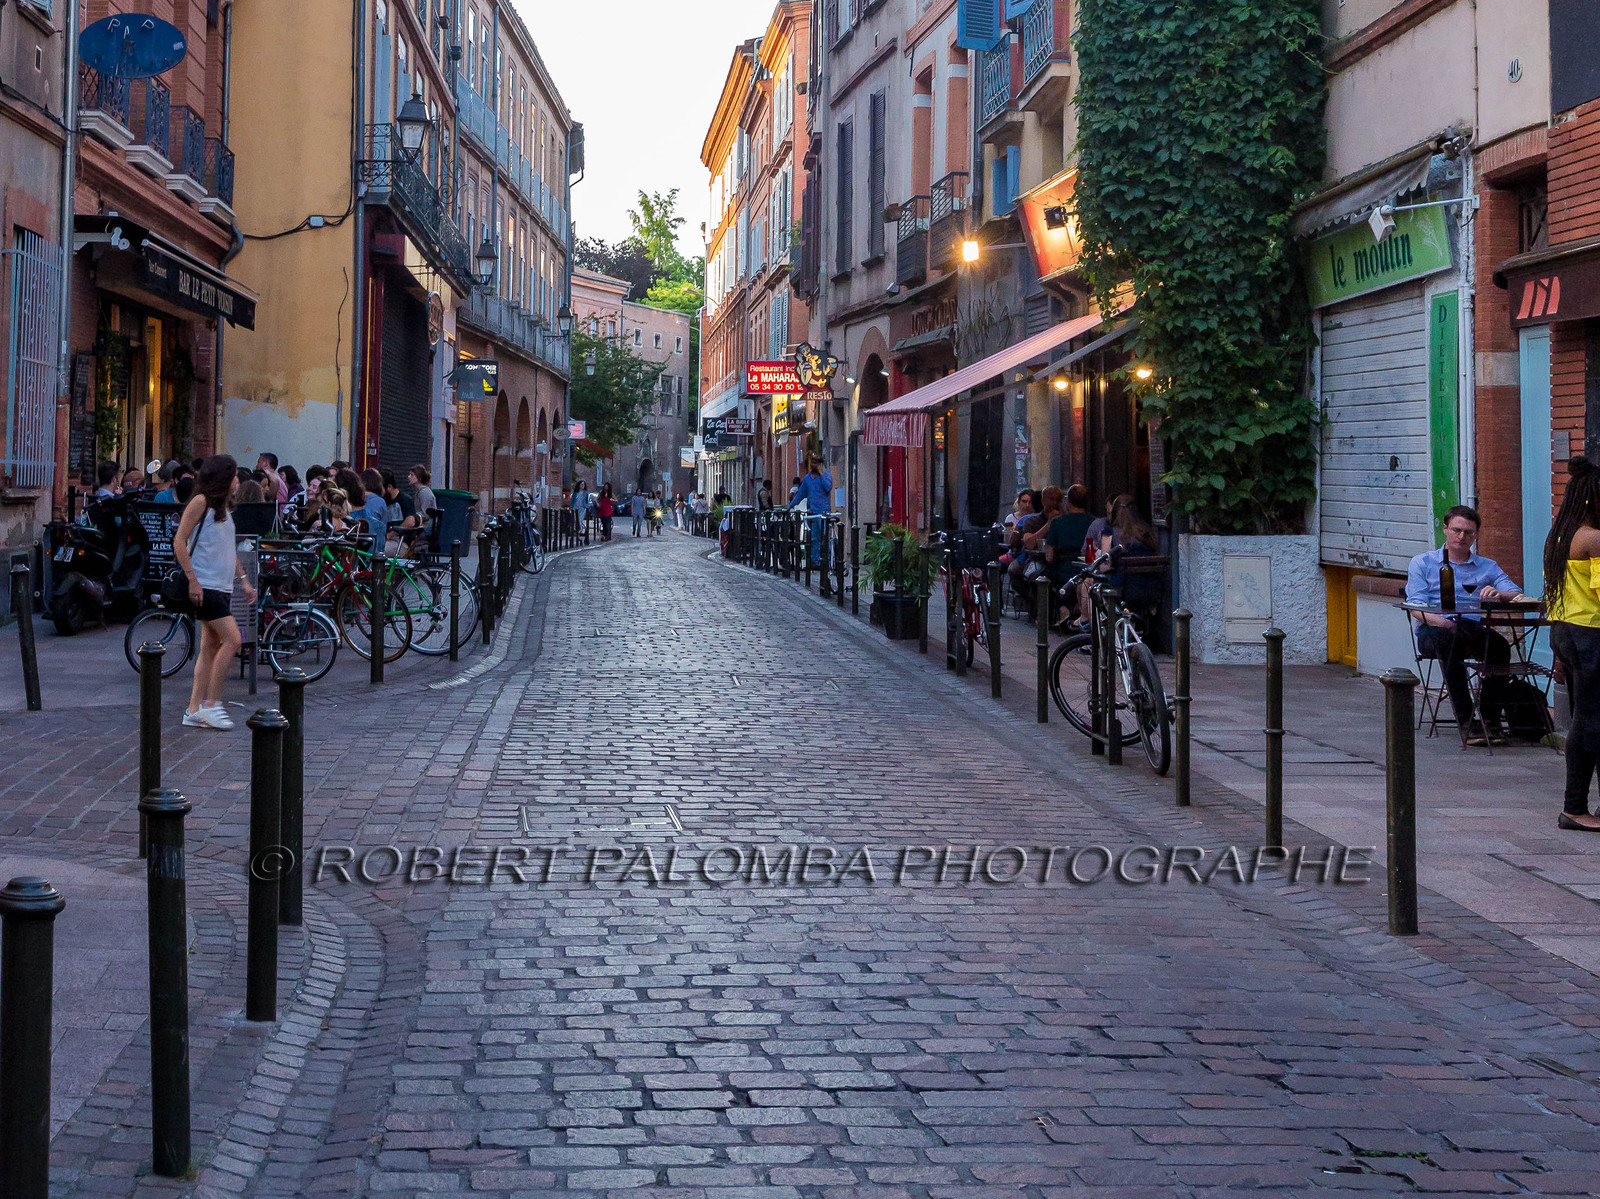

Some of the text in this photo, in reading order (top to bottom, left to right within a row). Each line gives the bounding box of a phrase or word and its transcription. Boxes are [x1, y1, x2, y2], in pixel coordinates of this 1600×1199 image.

[1329, 233, 1414, 288] le moulin
[178, 269, 191, 296] BAR
[191, 276, 200, 300] LE
[201, 281, 216, 307] PETIT
[749, 364, 784, 372] Restaurant
[747, 372, 758, 383] Le
[750, 383, 760, 391] 05
[761, 383, 771, 391] 34
[773, 383, 783, 391] 30
[785, 383, 795, 391] 50
[807, 391, 832, 400] RESTO
